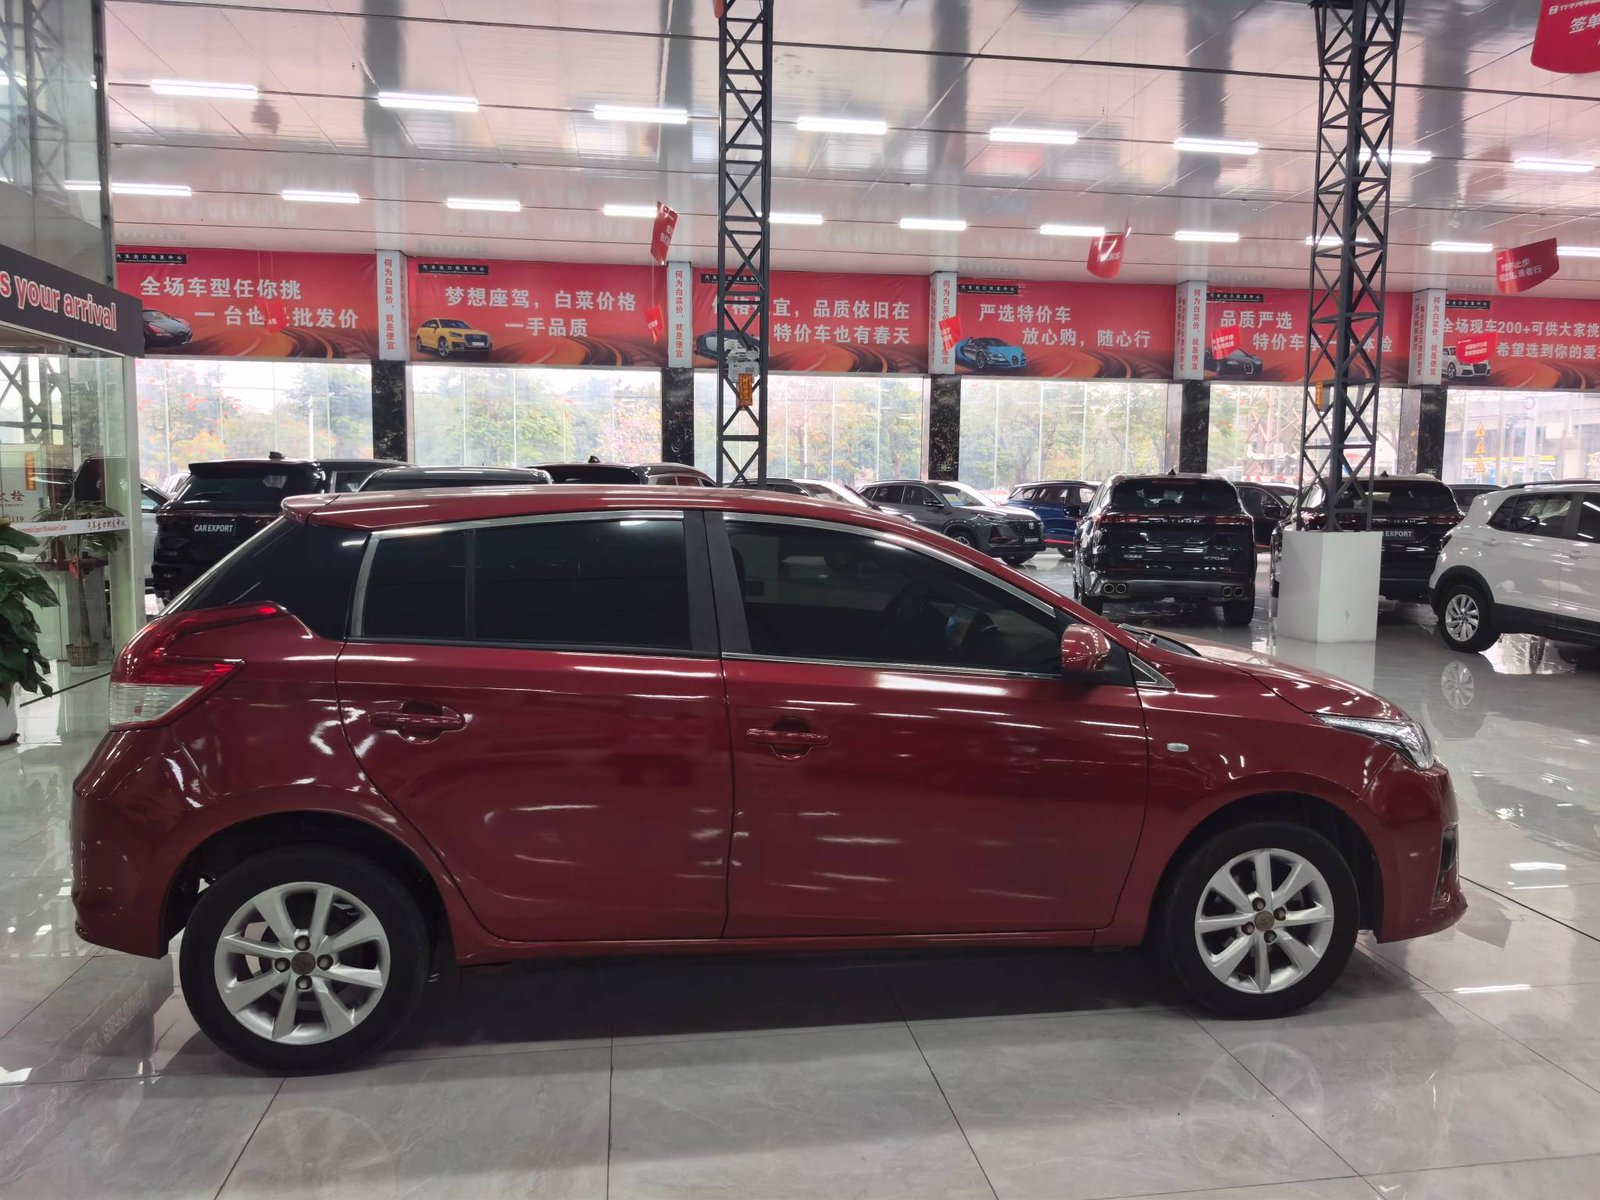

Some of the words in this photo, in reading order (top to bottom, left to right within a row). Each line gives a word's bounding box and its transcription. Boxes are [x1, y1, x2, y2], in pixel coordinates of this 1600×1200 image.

[140, 276, 302, 300] 全场车型任你挑
[14, 275, 61, 313] your
[63, 293, 117, 332] arrival
[444, 286, 636, 312] 梦想座驾，白菜价格
[194, 305, 359, 329] 一台也批发价
[979, 303, 1071, 324] 严选特价车
[1220, 310, 1293, 329] 品质严选
[504, 317, 588, 338] 一手品质
[773, 323, 910, 345] 特价车也有春天
[1022, 327, 1151, 348] 放心购，随心行
[1497, 342, 1600, 360] 希望选到你的爱
[194, 524, 207, 532] CAR
[207, 524, 234, 532] EXPORT
